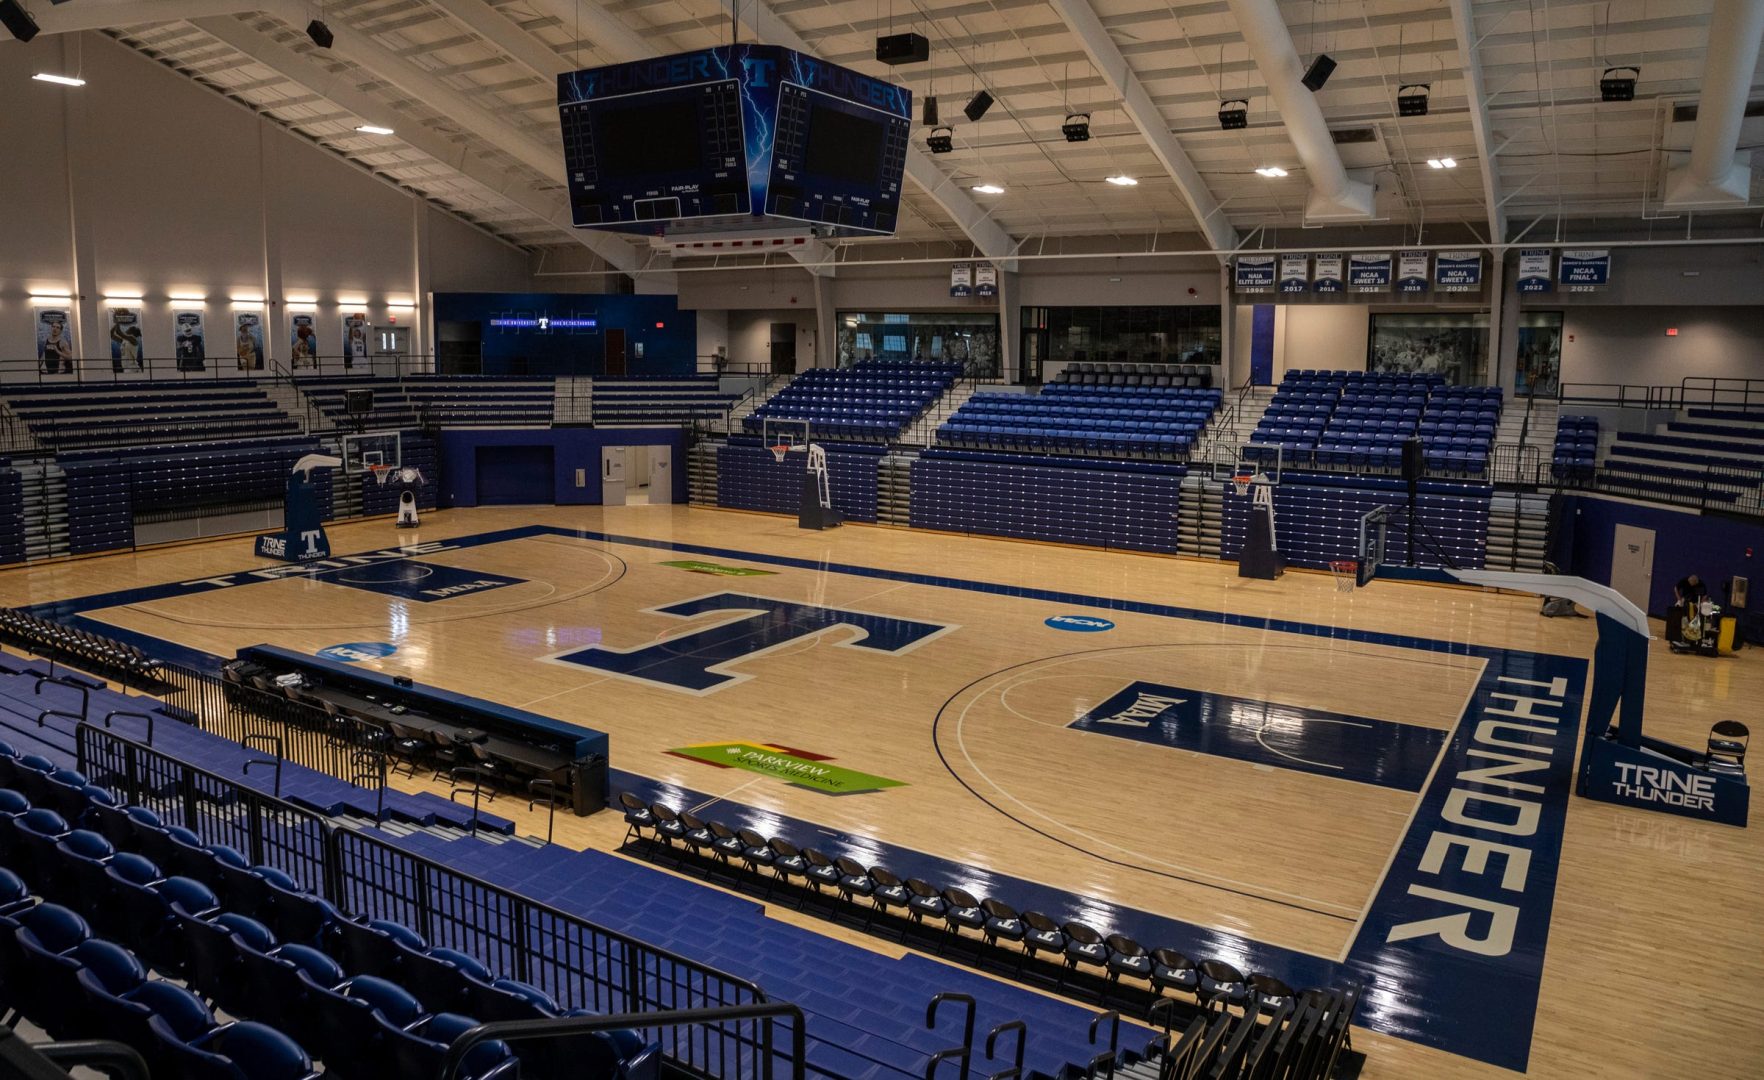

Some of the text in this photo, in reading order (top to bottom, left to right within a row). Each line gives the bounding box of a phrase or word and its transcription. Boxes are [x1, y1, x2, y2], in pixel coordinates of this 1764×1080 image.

[583, 56, 711, 96] THUNDER
[804, 60, 896, 109] THUNDER
[538, 318, 548, 329] T
[261, 546, 286, 557] THUNDER
[263, 536, 287, 550] TRINE
[297, 551, 327, 560] THUNDER
[301, 530, 321, 554] T
[1096, 691, 1189, 728] MIAA
[733, 757, 845, 788] SPORTS MEDICINE
[742, 751, 830, 776] PARKVIEW
[1614, 761, 1717, 798] TRINE
[1612, 781, 1715, 812] THUNDER
[1386, 676, 1568, 957] THUNDER
